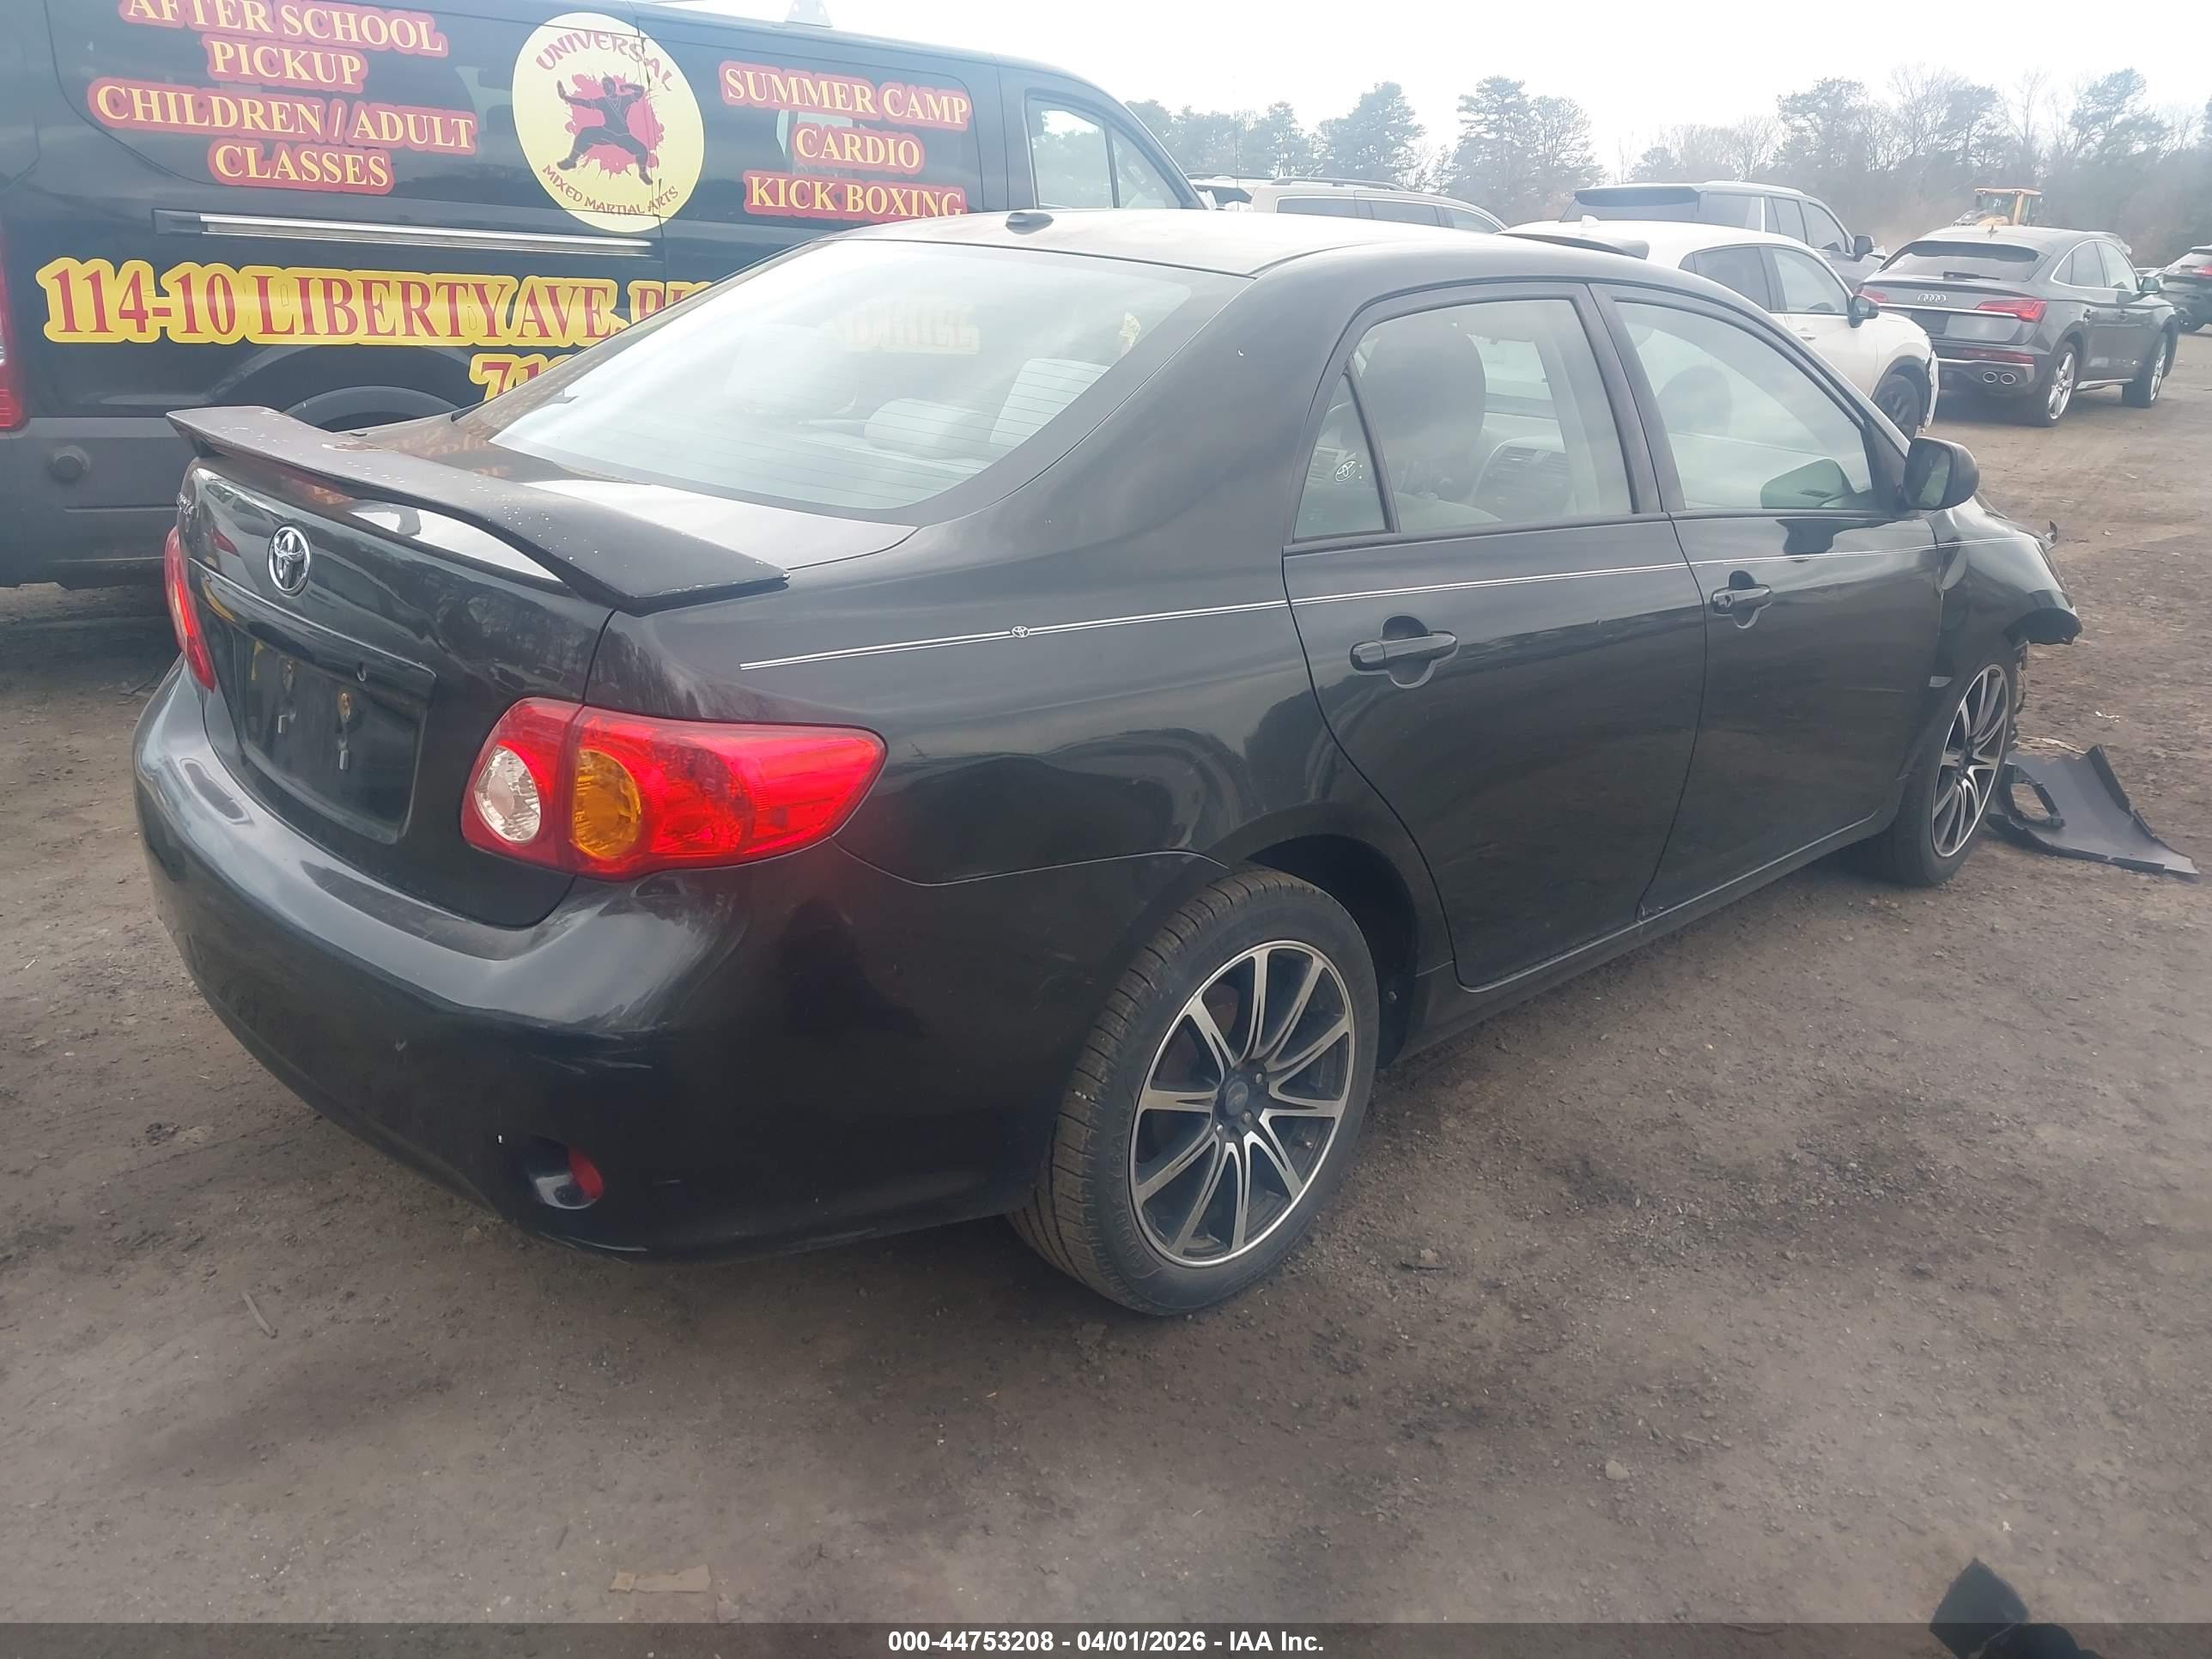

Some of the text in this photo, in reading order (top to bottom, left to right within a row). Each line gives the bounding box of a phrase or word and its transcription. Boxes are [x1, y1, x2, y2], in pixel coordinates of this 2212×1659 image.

[127, 0, 443, 52] AFTER SCHOOL
[209, 40, 362, 86] PICKUP
[535, 31, 674, 92] UNIVERSAL
[96, 84, 322, 137] CHILDREN
[352, 109, 474, 149] ADULT
[725, 68, 969, 125] SUMMER CAMP
[214, 143, 389, 188] CLASSES
[795, 127, 921, 168] CARDIO
[542, 164, 679, 216] MIXED MARTIAL ARTS
[749, 175, 963, 217] KICK BOXING
[51, 267, 237, 336] 114-10
[250, 275, 508, 338] LIBERTY
